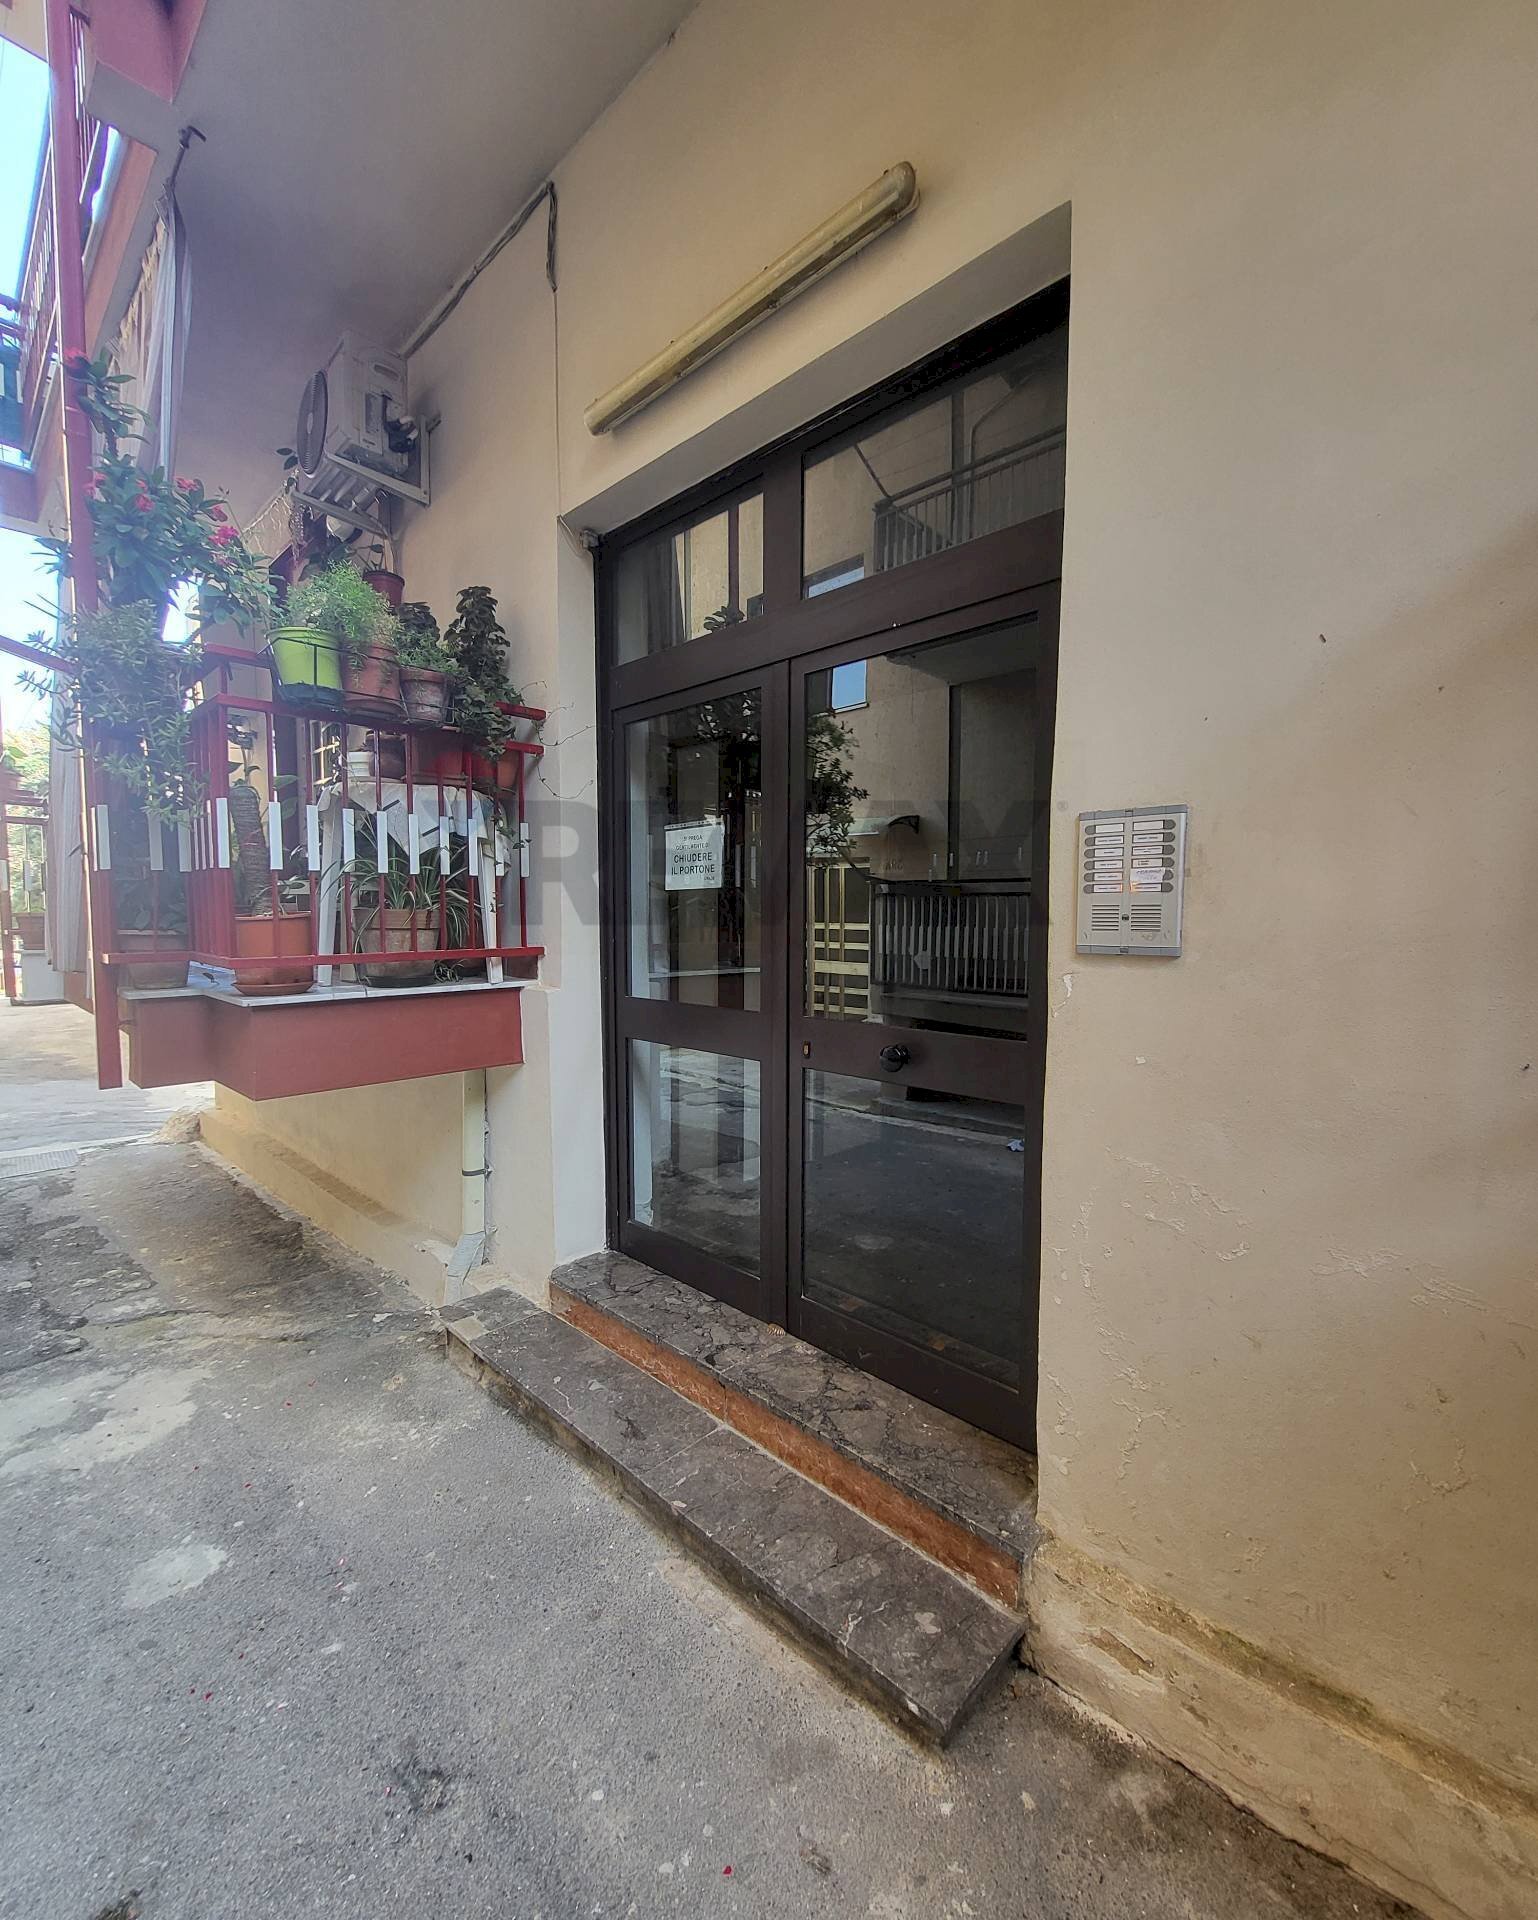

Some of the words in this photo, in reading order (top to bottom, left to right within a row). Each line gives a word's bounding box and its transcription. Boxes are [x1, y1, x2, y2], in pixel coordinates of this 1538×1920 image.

[673, 852, 713, 863] CHIUDERE
[671, 866, 678, 875] IL
[679, 864, 715, 875] PORTONE
